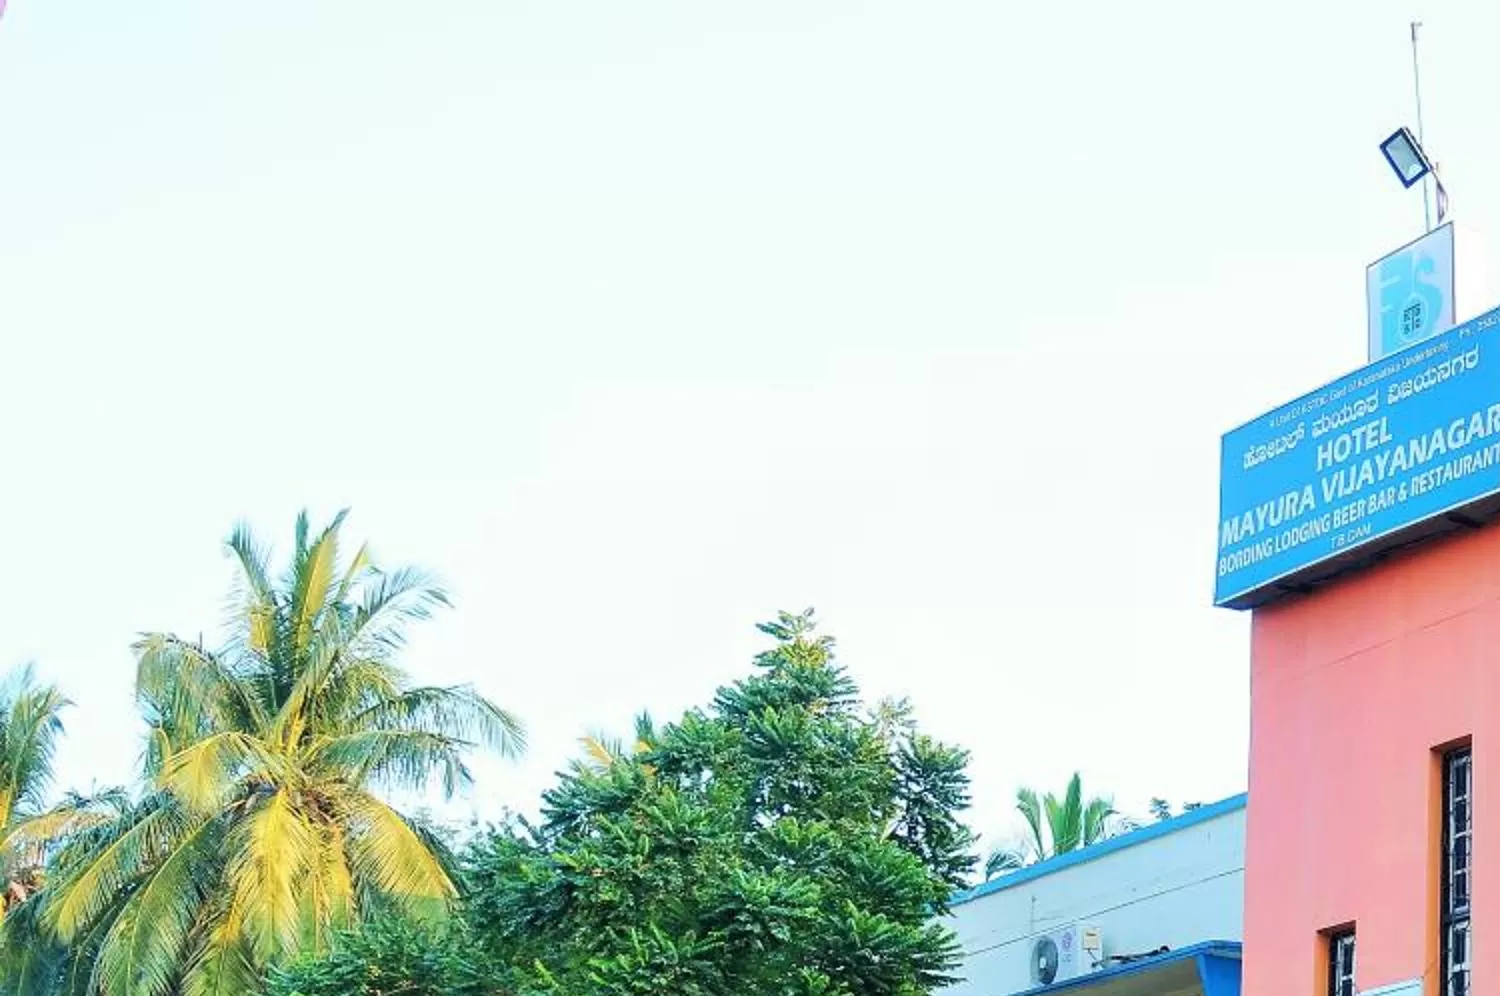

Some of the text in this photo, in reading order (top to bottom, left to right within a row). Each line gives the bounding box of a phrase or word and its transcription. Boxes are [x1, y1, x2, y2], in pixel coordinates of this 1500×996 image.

[1315, 416, 1392, 472] HOTEL
[1218, 535, 1273, 577] BORDING
[1275, 512, 1331, 553] LODGING
[1333, 498, 1366, 530] BEER
[1367, 485, 1395, 516] BAR
[1397, 481, 1409, 503] &
[1220, 483, 1316, 548] MAYURA
